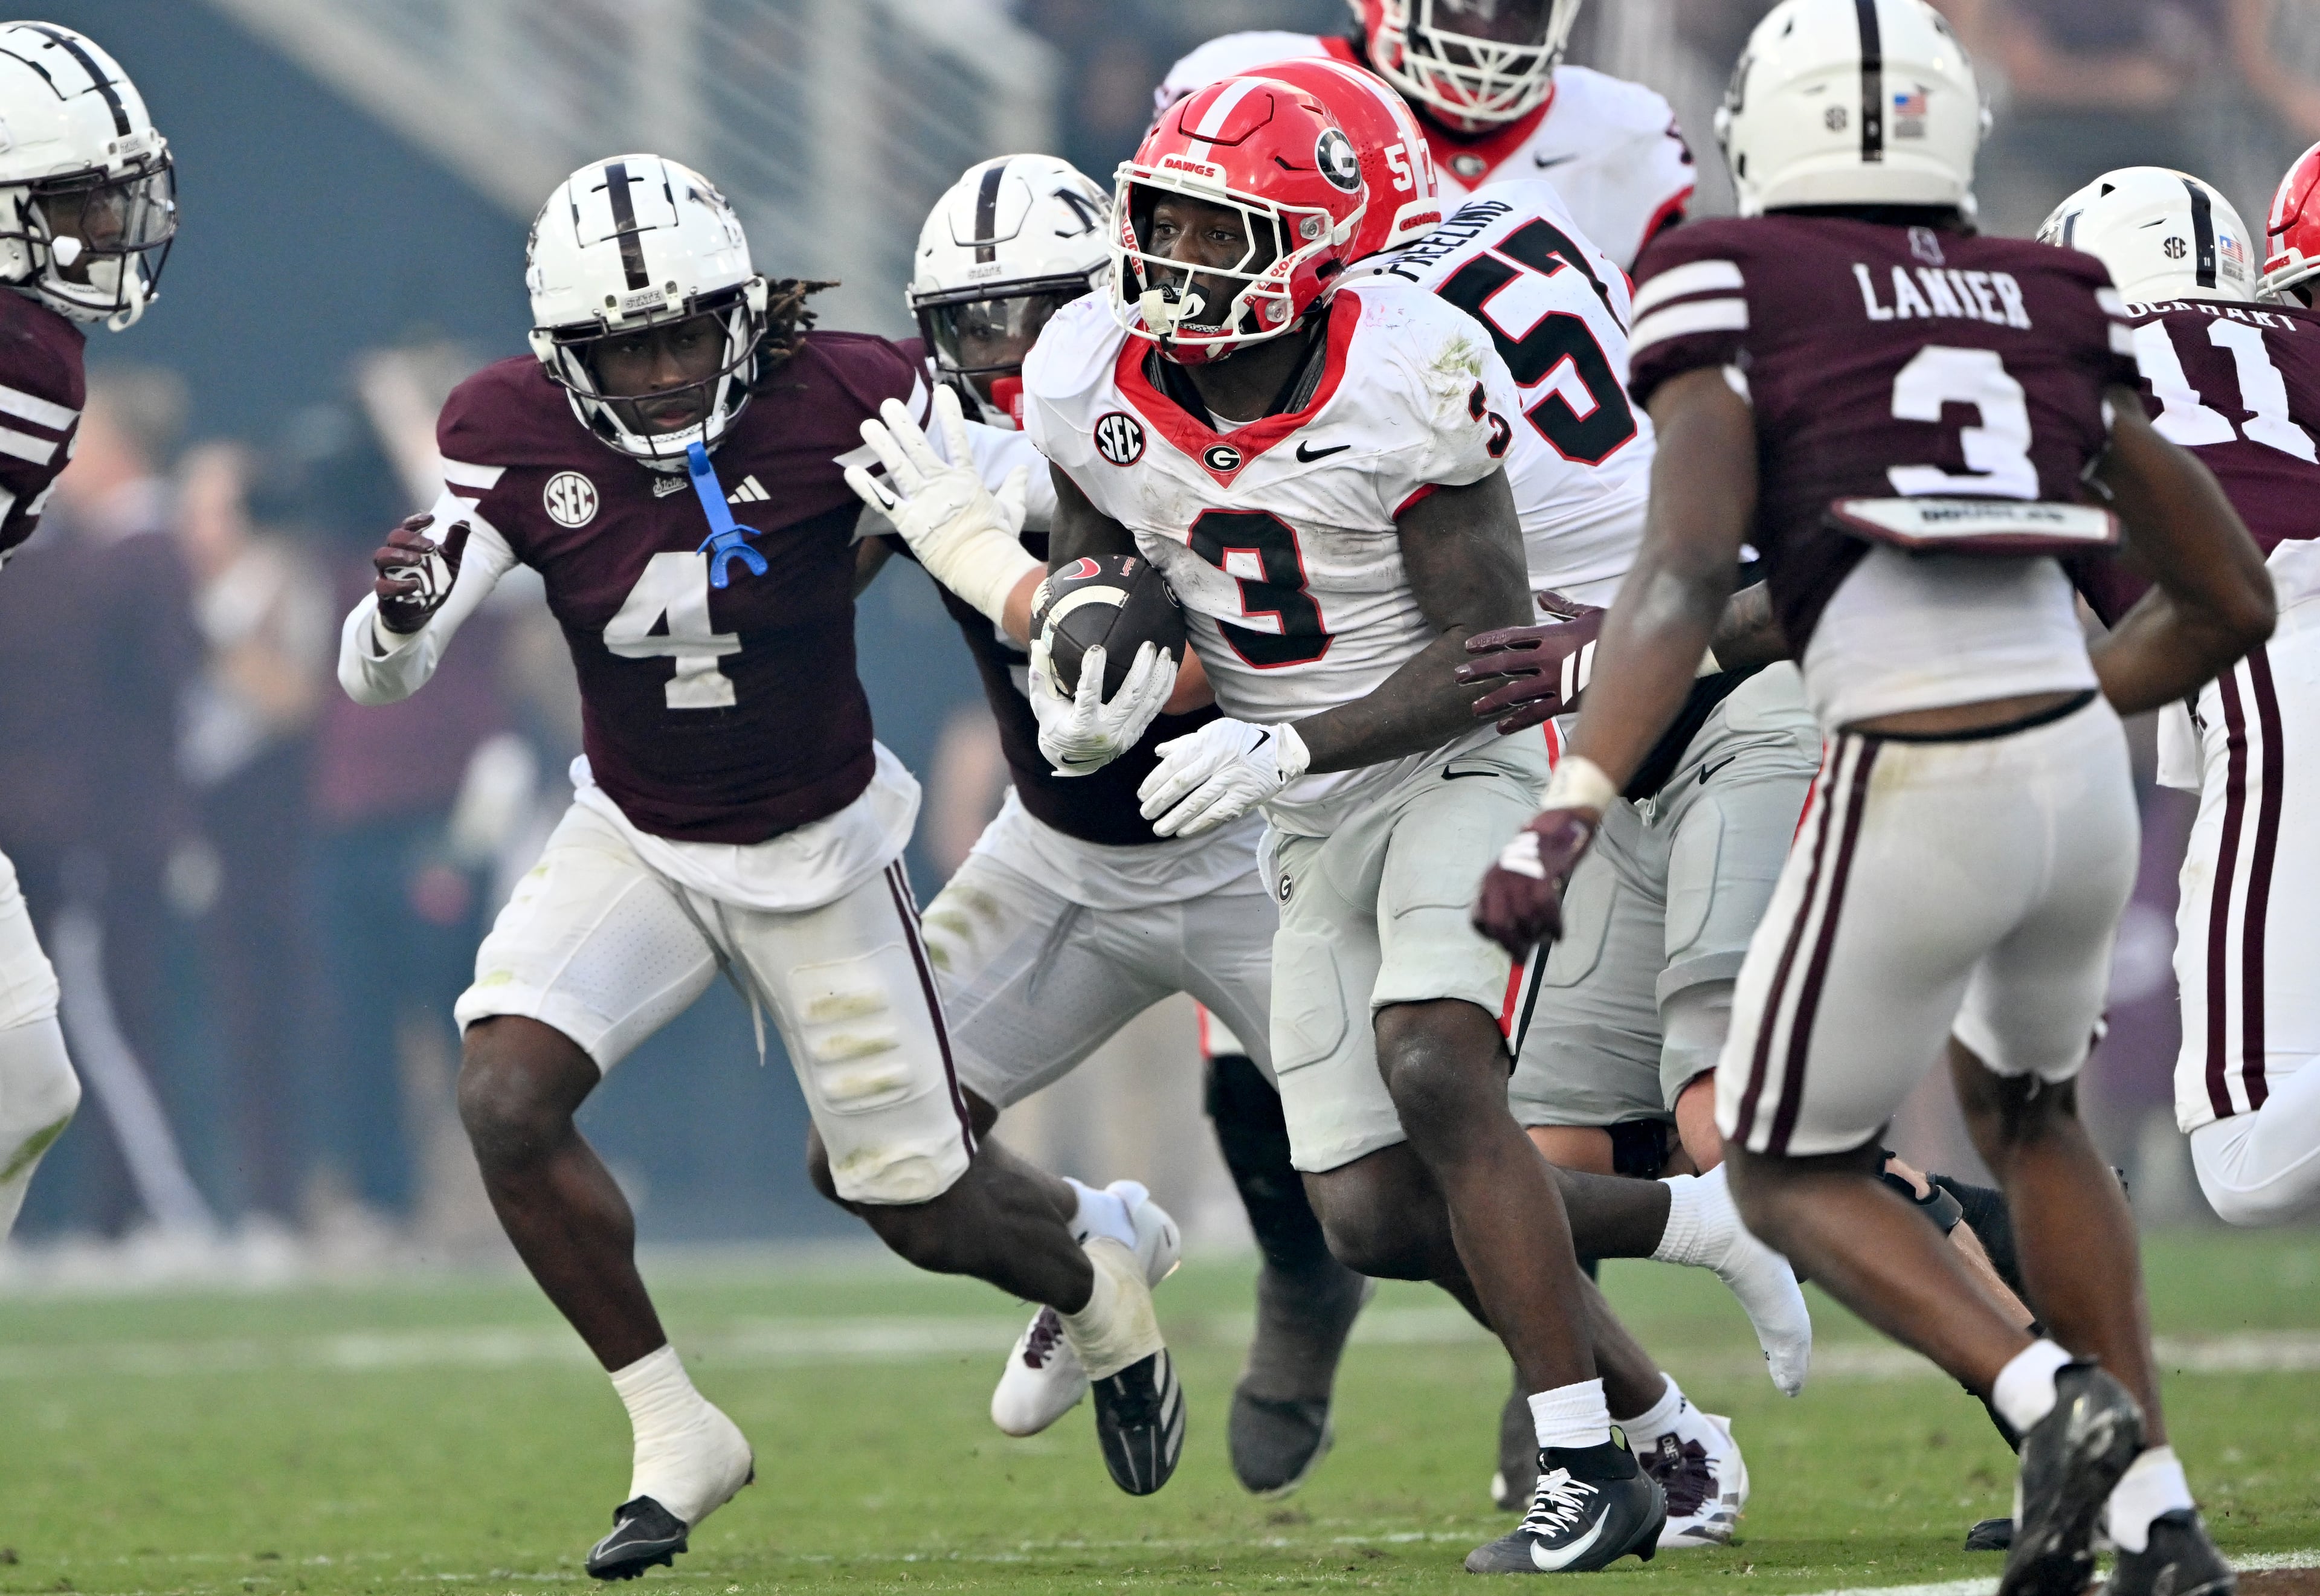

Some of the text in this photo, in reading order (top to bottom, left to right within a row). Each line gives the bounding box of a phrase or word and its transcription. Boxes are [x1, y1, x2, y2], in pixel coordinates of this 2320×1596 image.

[1164, 158, 1216, 178] DAWGS
[1384, 138, 1436, 192] 57
[2163, 236, 2187, 259] SEC
[2203, 256, 2211, 267] 11
[625, 290, 661, 308] STATE
[1852, 262, 2033, 330] LANIER
[1434, 216, 1638, 467] 57
[2133, 318, 2319, 465] 11
[1097, 414, 1142, 465] SEC
[1886, 344, 2040, 501] 3
[1210, 448, 1240, 469] G
[547, 474, 595, 525] SEC
[653, 477, 688, 497] State
[1187, 508, 1336, 670] 3
[603, 552, 743, 709] 4
[1280, 877, 1292, 898] G
